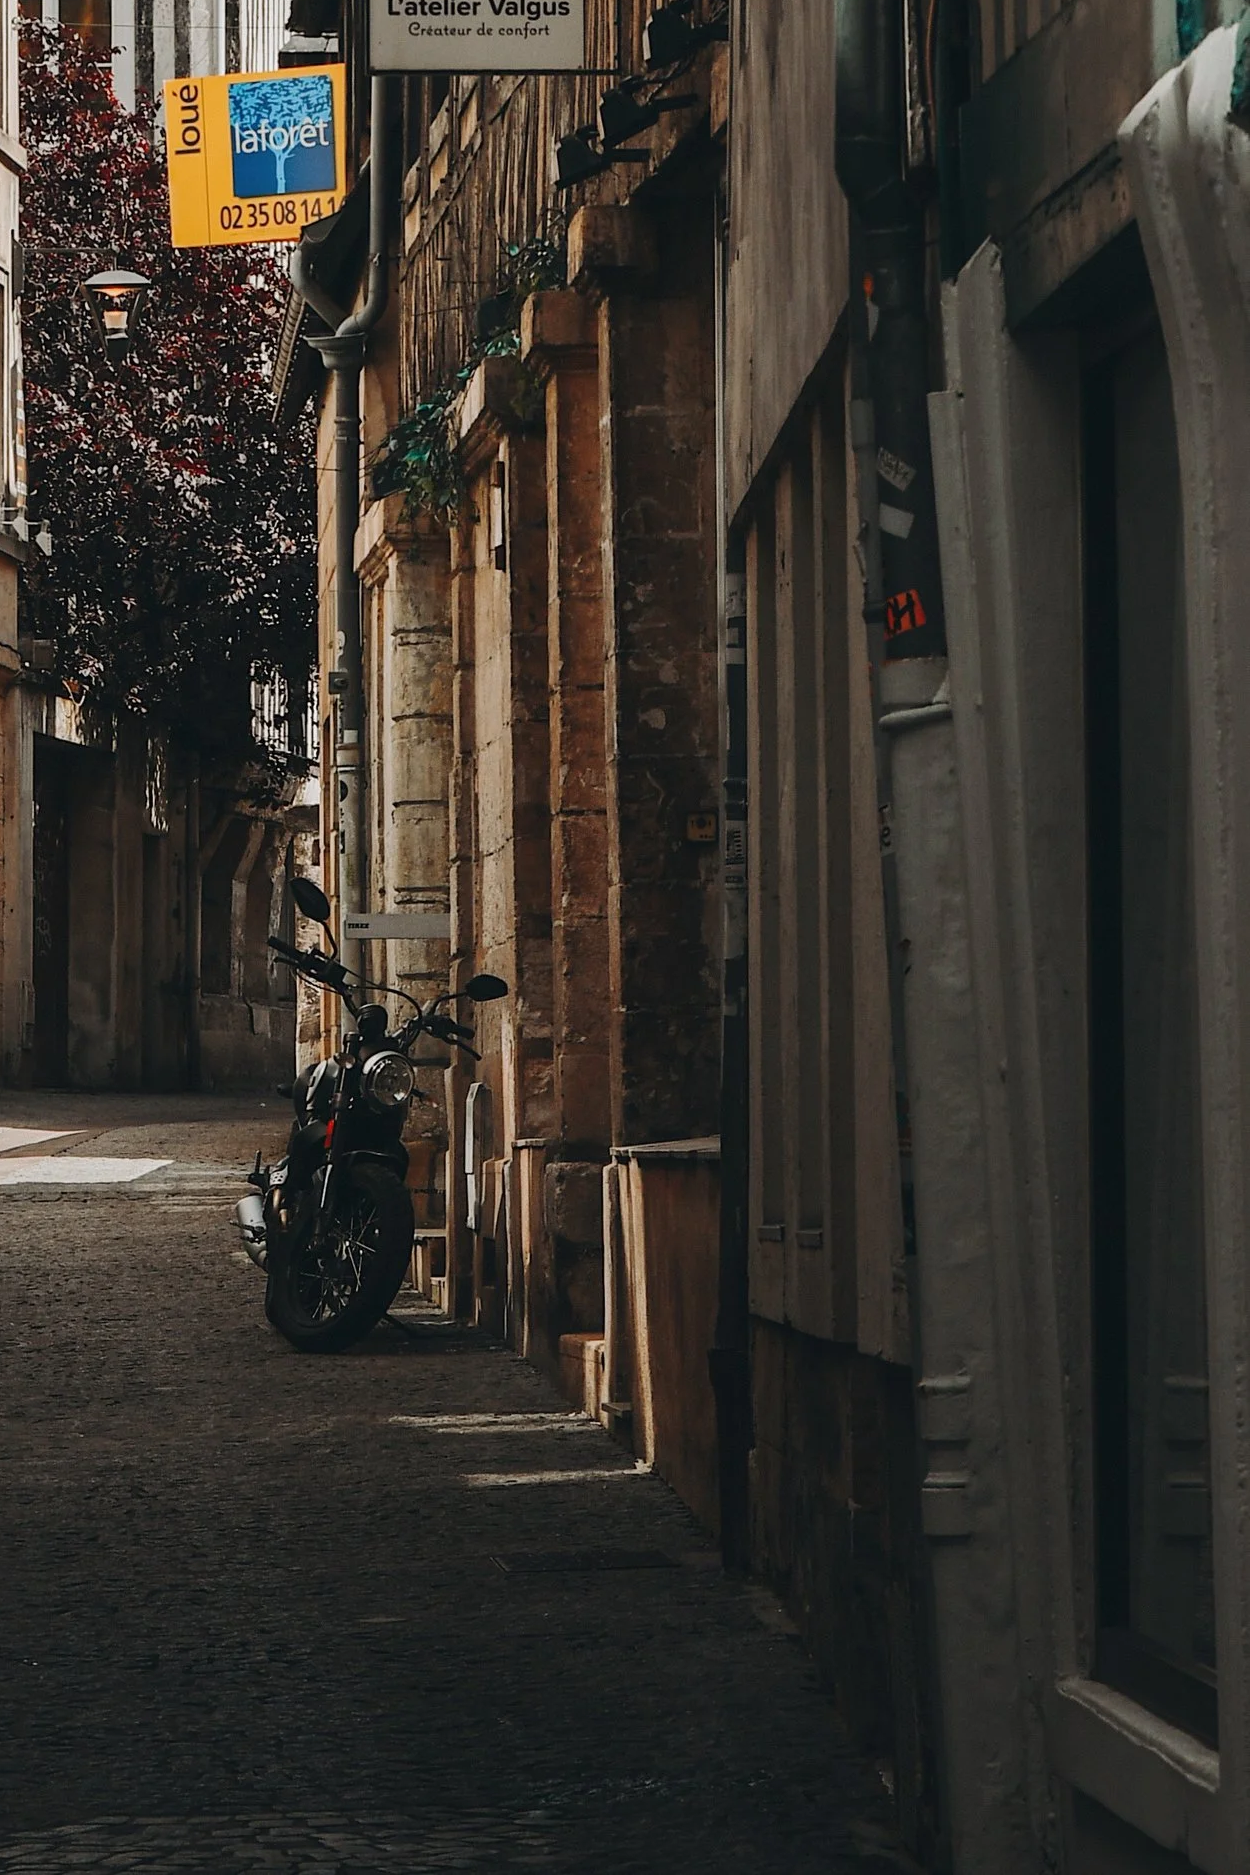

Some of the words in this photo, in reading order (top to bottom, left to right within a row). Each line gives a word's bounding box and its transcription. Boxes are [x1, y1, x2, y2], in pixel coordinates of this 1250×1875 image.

[408, 21, 472, 36] Créateur
[476, 22, 493, 36] de
[498, 21, 550, 40] confort
[172, 84, 201, 156] loué
[235, 116, 330, 154] laforêt
[220, 205, 243, 230] 02
[247, 203, 269, 228] 35
[273, 200, 297, 225] 08
[300, 198, 322, 223] 14
